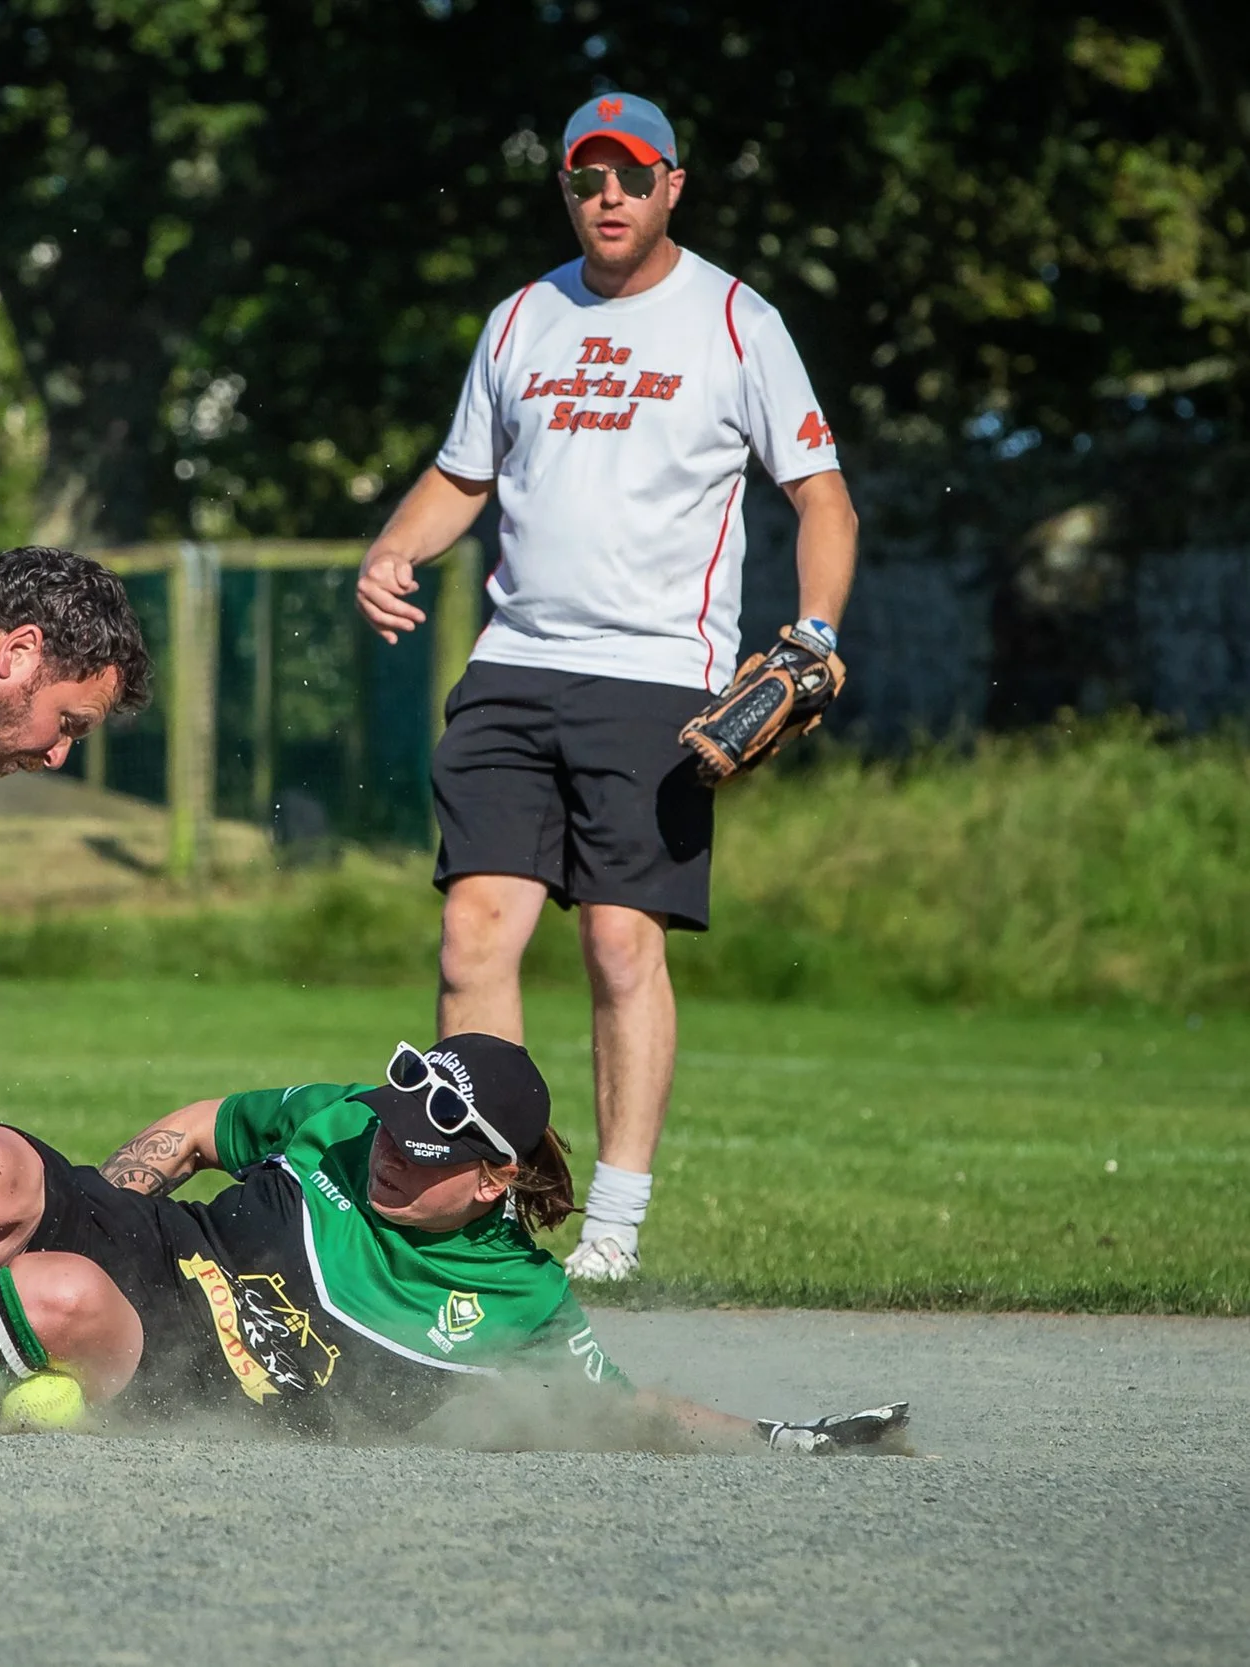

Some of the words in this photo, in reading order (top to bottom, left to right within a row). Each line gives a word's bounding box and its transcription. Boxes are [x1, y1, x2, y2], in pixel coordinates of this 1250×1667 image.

[576, 336, 633, 365] The
[521, 368, 627, 401] Lock-in
[628, 371, 684, 401] Hit
[547, 401, 640, 436] Squad
[405, 1139, 450, 1154] CHROME
[413, 1149, 442, 1160] SOFT
[309, 1170, 352, 1211] mitre
[199, 1265, 258, 1378] FOODS
